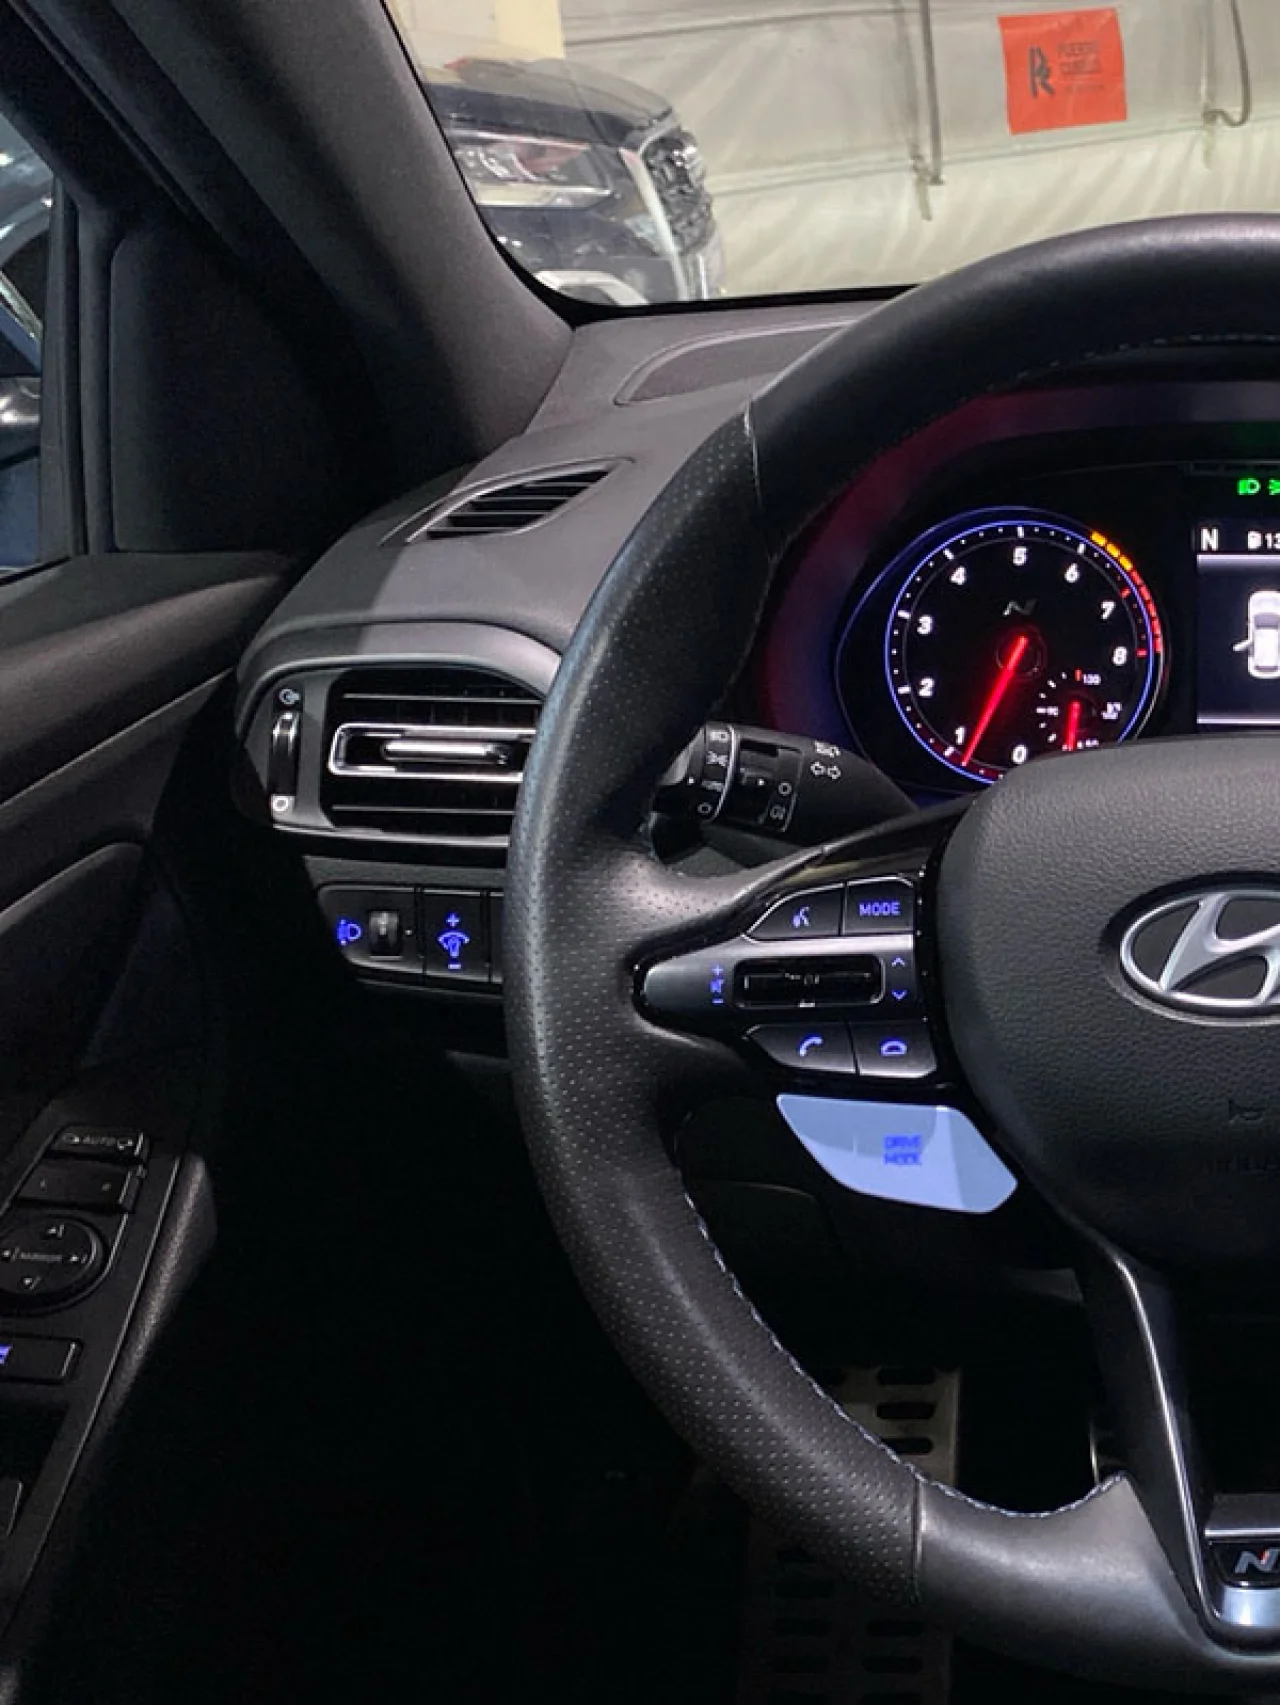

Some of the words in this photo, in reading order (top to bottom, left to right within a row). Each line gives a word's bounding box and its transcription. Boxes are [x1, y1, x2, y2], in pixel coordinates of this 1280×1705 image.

[1200, 528, 1219, 550] N
[1013, 546, 1028, 566] 5
[950, 565, 968, 585] 4
[1064, 563, 1080, 583] 6
[1101, 601, 1116, 620] 7
[916, 615, 933, 636] 3
[1112, 646, 1128, 666] 8
[918, 677, 935, 697] 2
[956, 725, 967, 745] 1
[1012, 744, 1028, 765] 0
[859, 902, 900, 916] MODE
[884, 1135, 922, 1150] DRIVE
[884, 1152, 921, 1165] MODE
